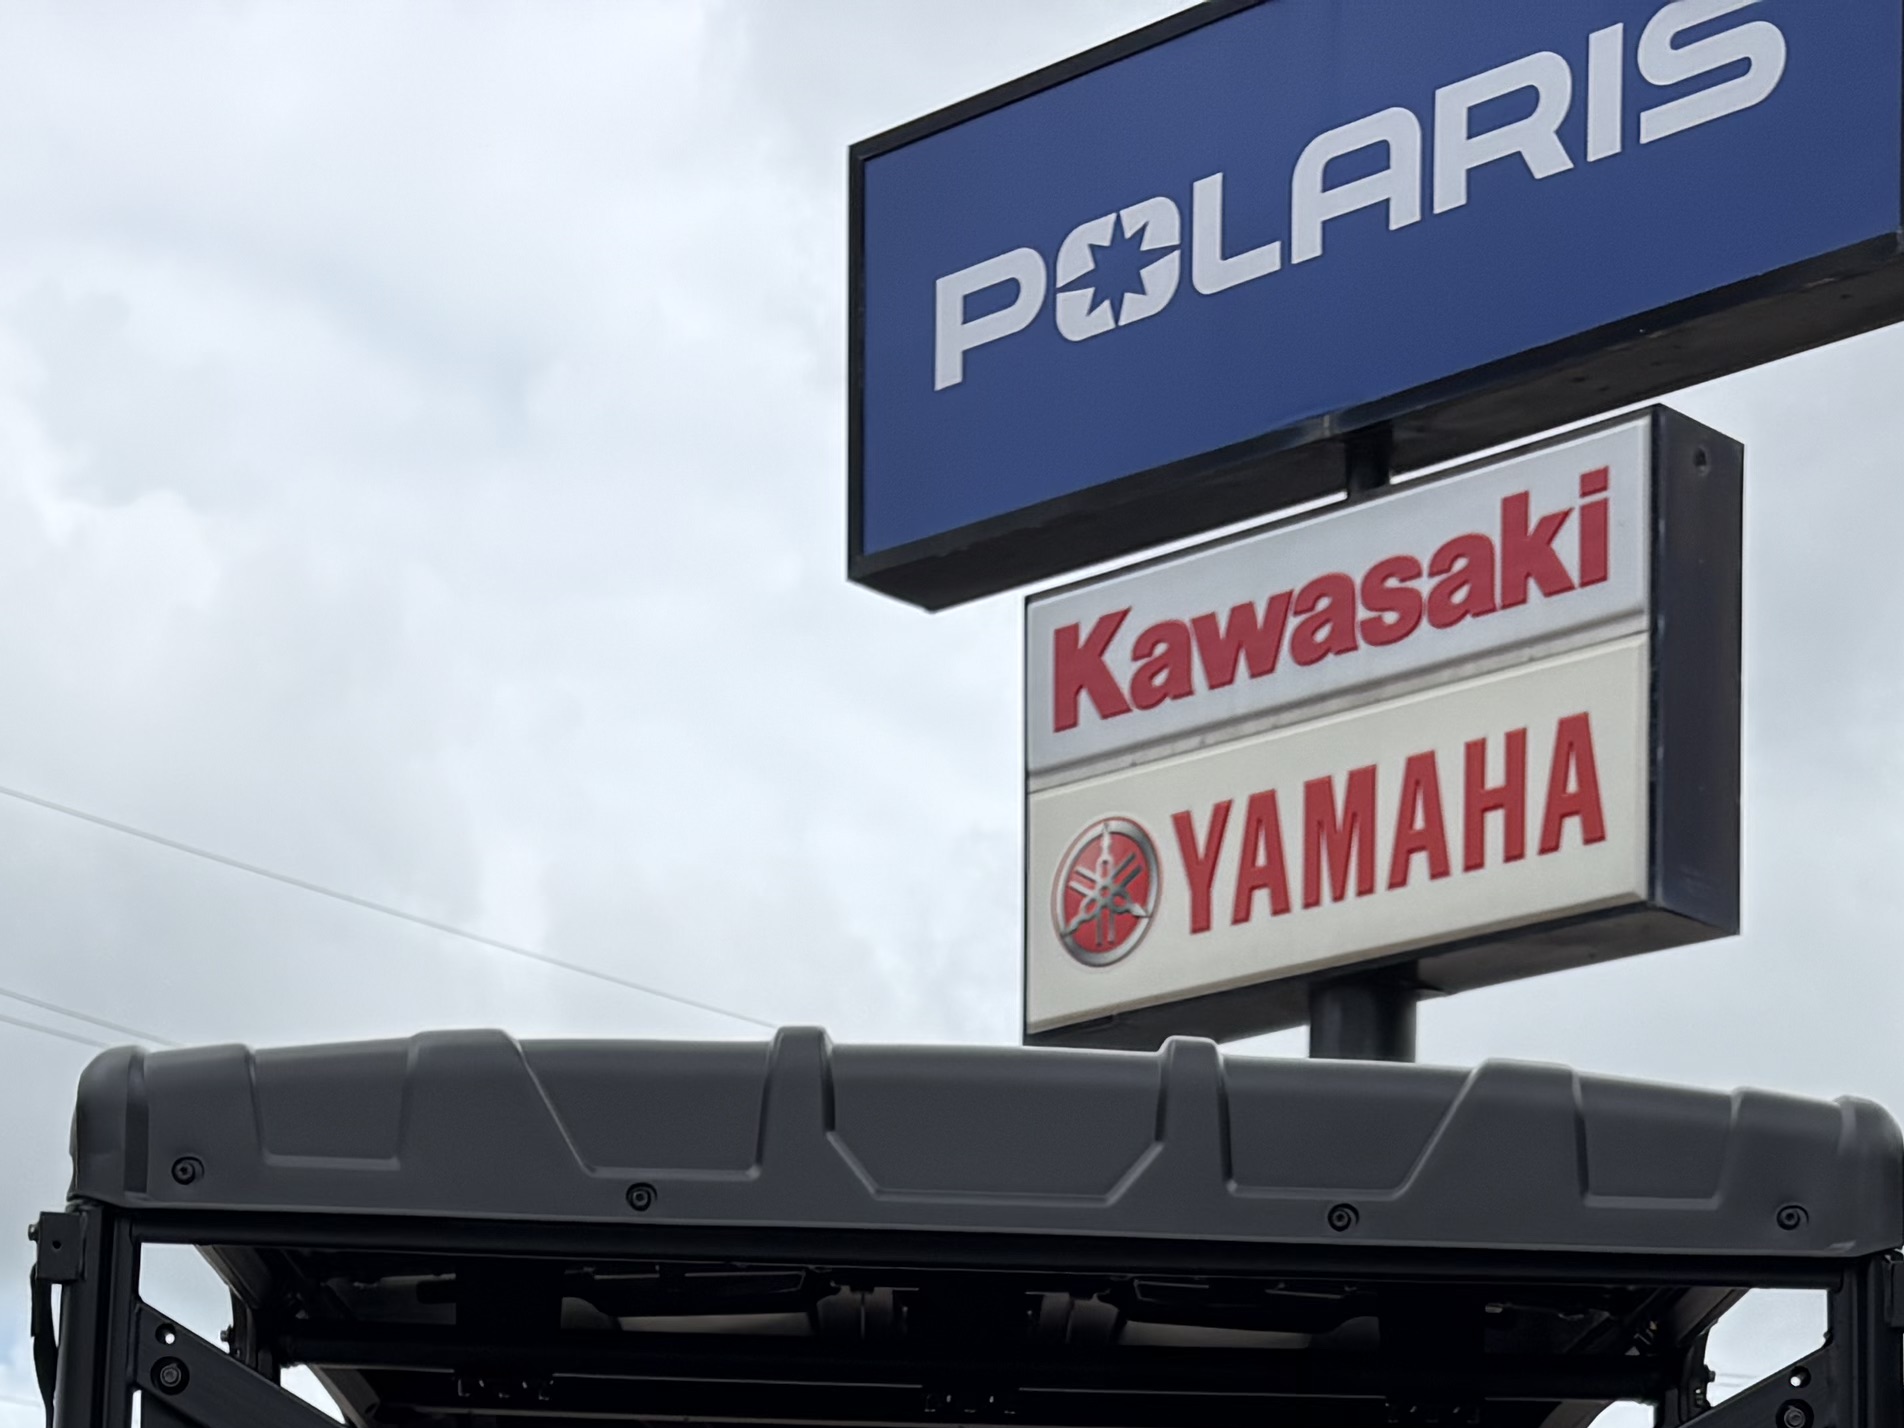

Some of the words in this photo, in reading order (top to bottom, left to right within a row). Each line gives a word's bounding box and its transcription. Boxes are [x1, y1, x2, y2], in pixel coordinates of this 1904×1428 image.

[934, 0, 1787, 390] POLARIS
[1052, 465, 1611, 733] Kawasaki
[1170, 711, 1607, 934] YAMAHA
